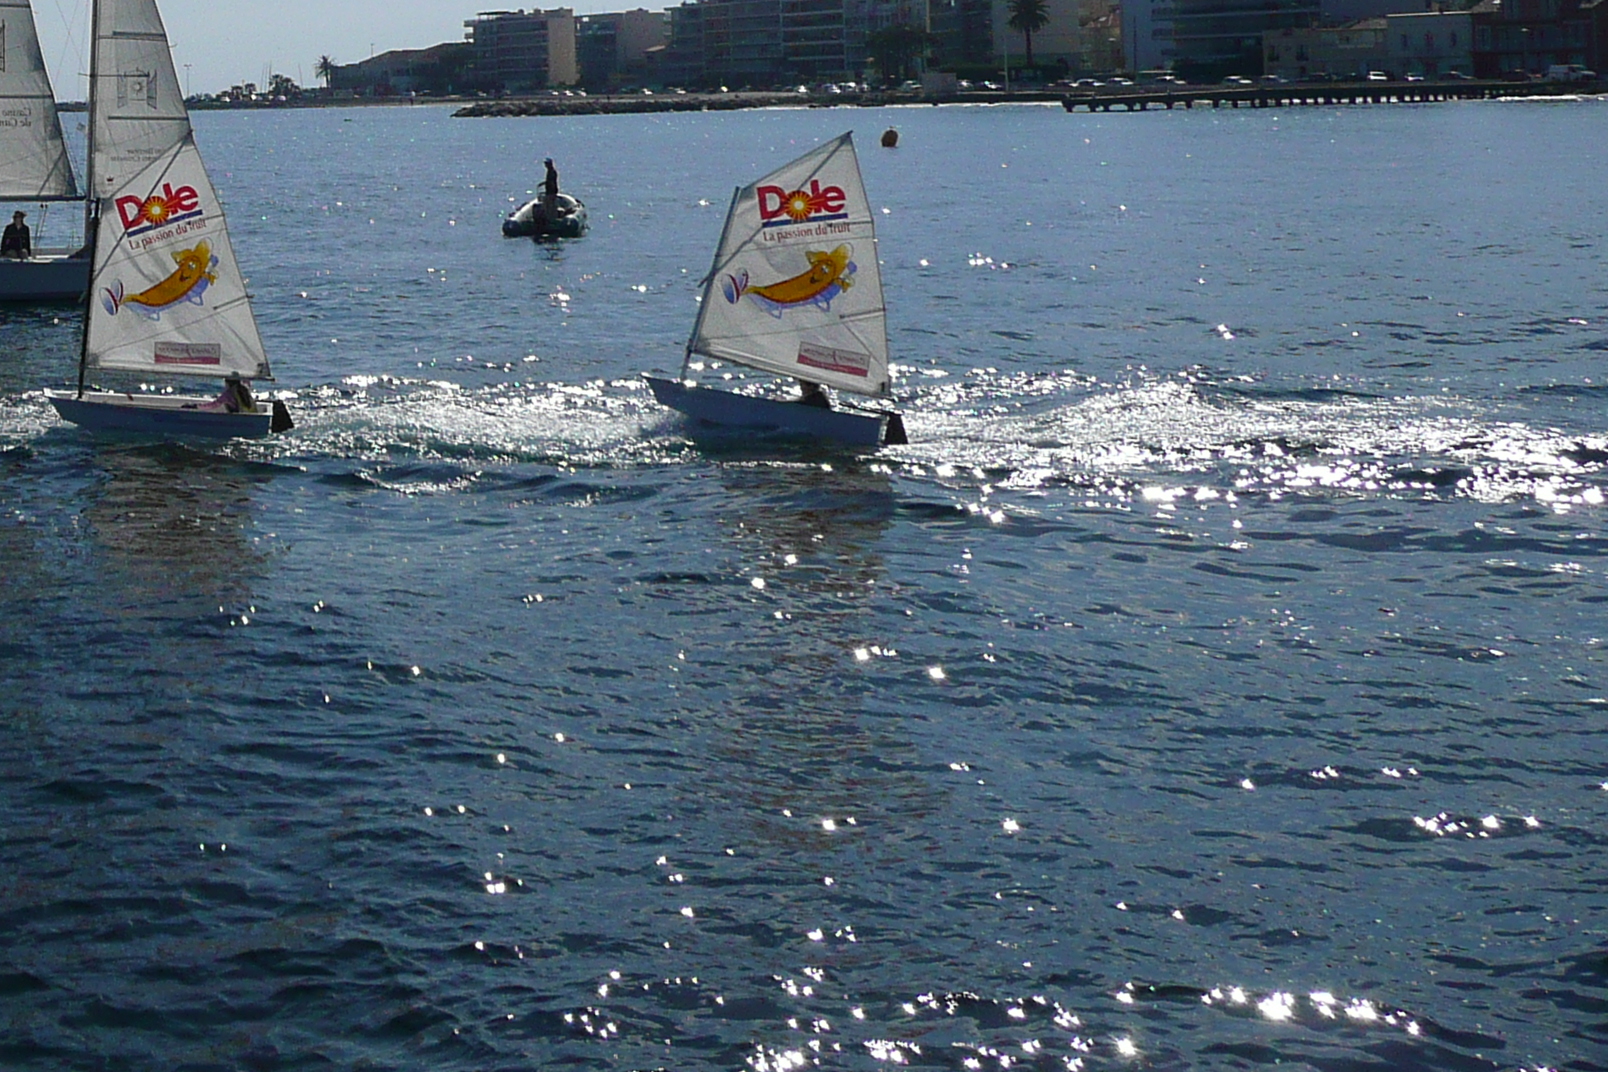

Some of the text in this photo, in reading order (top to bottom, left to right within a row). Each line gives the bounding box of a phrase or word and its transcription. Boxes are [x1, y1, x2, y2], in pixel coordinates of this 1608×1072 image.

[115, 183, 199, 230] Dole
[756, 179, 846, 221] Dole
[128, 240, 140, 250] La
[141, 231, 174, 250] passion
[176, 224, 187, 235] du
[763, 231, 775, 242] La
[777, 228, 812, 243] passion
[815, 224, 827, 235] du
